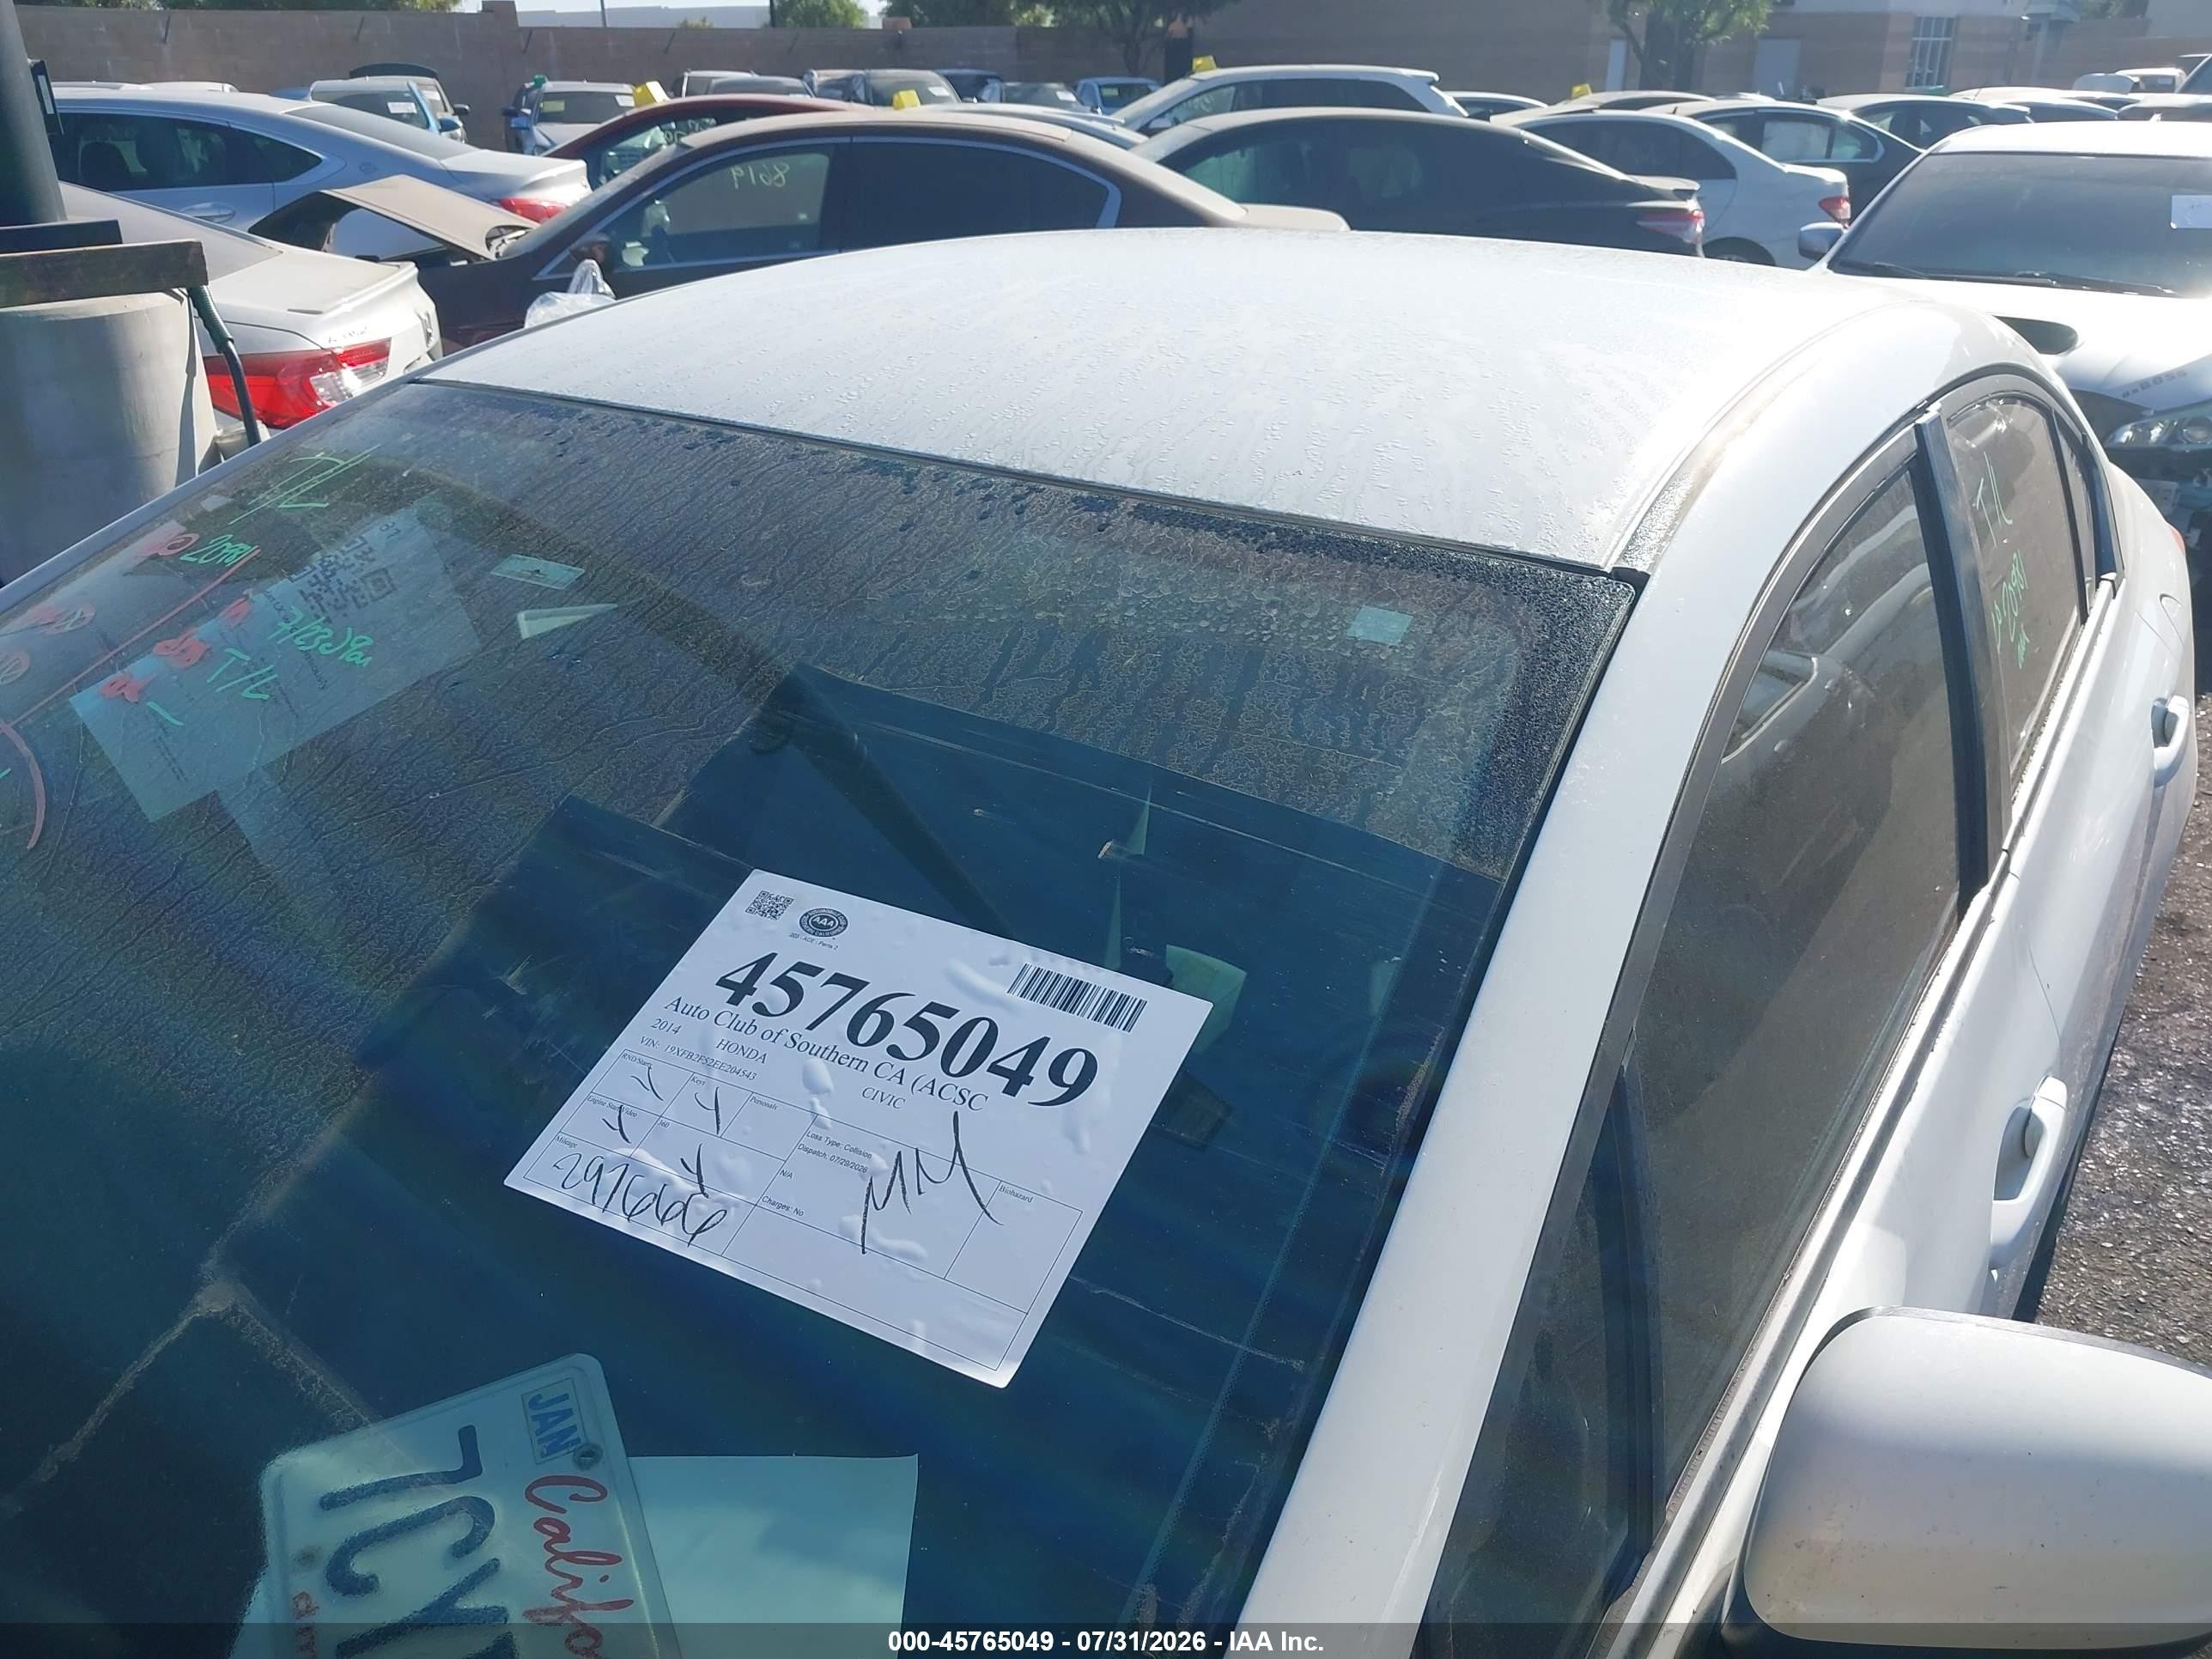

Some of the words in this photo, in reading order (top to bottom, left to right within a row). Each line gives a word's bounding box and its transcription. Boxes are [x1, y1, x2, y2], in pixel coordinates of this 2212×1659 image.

[812, 916, 835, 927] AAA
[651, 1018, 682, 1036] 2014
[714, 951, 1099, 1108] 45765049
[640, 1036, 660, 1049] VIN:
[665, 995, 710, 1021] Auto
[714, 1011, 758, 1037] Club
[760, 1028, 789, 1044] of
[783, 1031, 870, 1073] Southern
[873, 1060, 906, 1085] CA
[910, 1073, 989, 1112] (ACSC
[716, 1038, 768, 1065] HONDA
[690, 1076, 707, 1086] Keys
[587, 1095, 607, 1108] Engine
[750, 1096, 779, 1110] Personals
[860, 1087, 906, 1110] CIVIC
[556, 1135, 578, 1149] Mileage
[806, 1130, 823, 1142] Loss
[824, 1136, 842, 1150] Type:
[843, 1144, 873, 1159] Collision
[798, 1143, 829, 1160] Dispatch:
[830, 1154, 869, 1174] 07/29/2026
[780, 1169, 793, 1180] N/A
[762, 1195, 792, 1213] Charges:
[793, 1208, 805, 1217] No
[999, 1184, 1035, 1206] Biohazard
[527, 1392, 584, 1457] JAN
